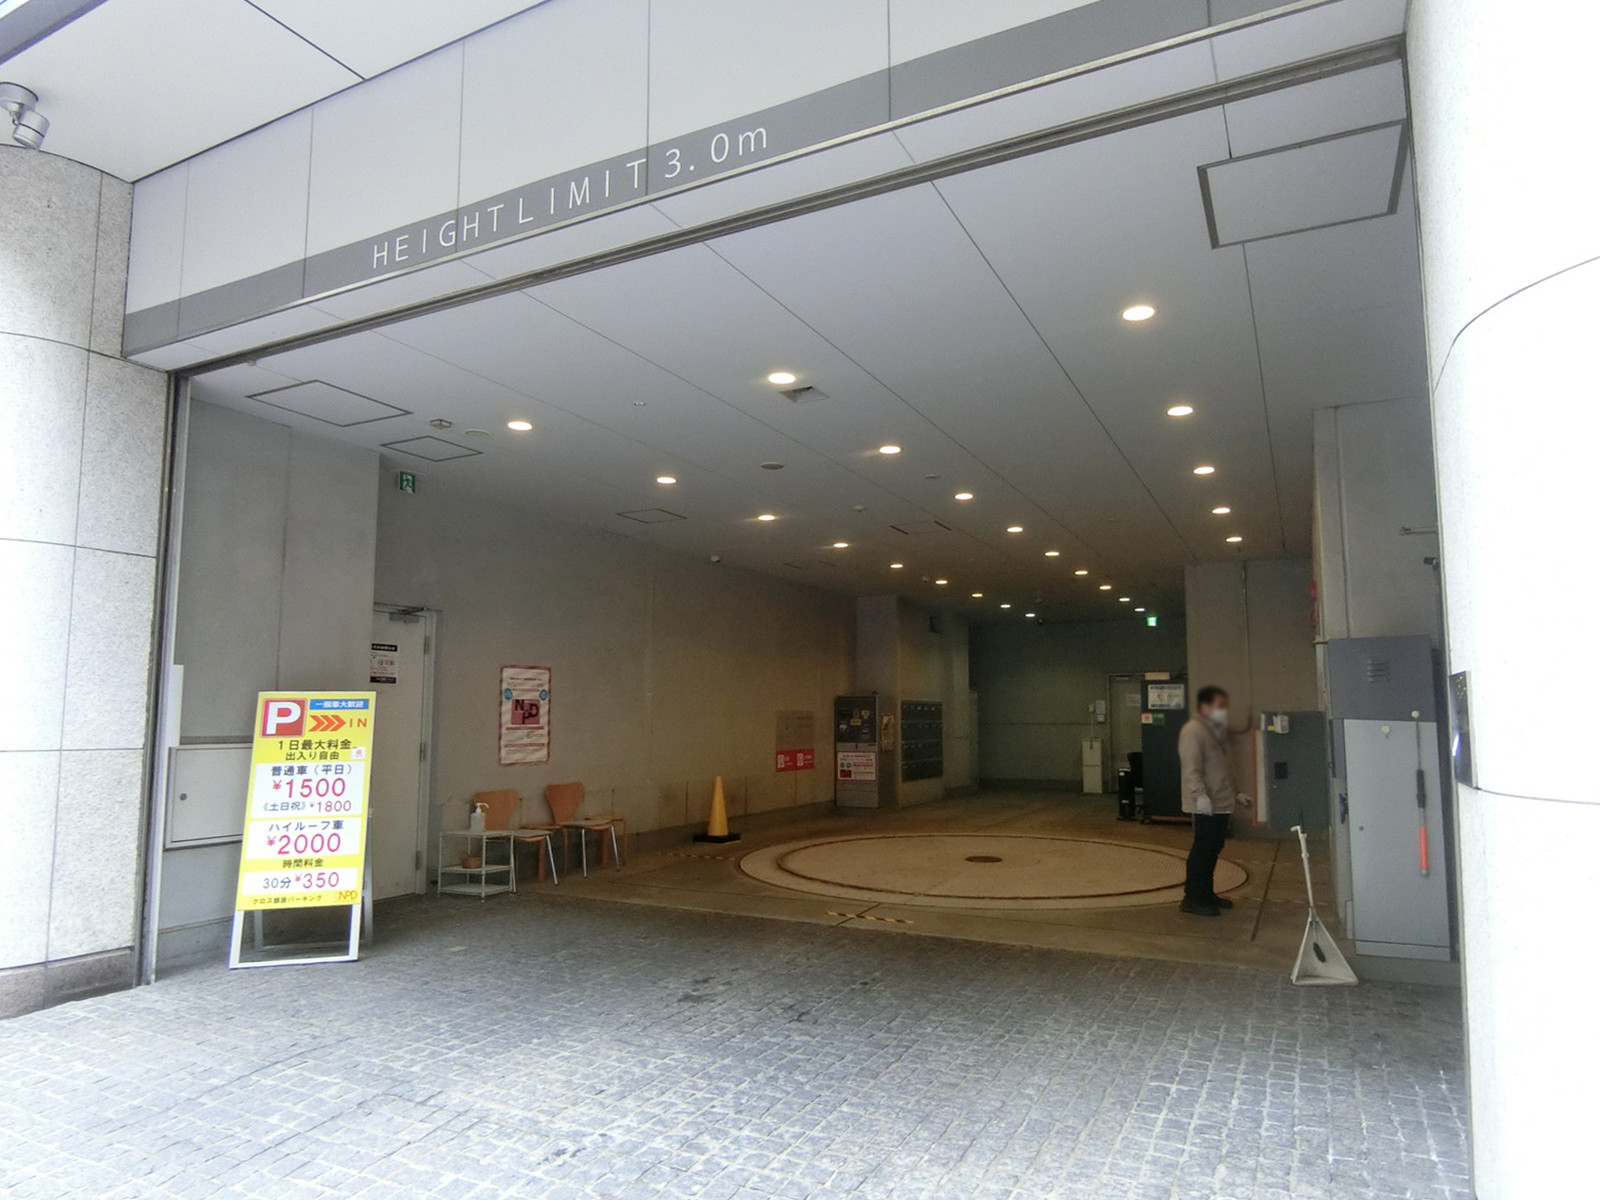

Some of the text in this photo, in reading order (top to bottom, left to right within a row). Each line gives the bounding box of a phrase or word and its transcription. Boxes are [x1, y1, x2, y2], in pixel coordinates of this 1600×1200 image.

[373, 204, 504, 268] HEIGHT
[518, 158, 647, 223] LIMIT
[265, 701, 302, 735] P
[349, 718, 367, 728] IN
[286, 751, 340, 761] 出入り自由
[272, 778, 346, 798] ¥1500
[268, 820, 344, 832] ハイルーフ車
[267, 833, 341, 855] ¥2000
[282, 858, 324, 868] 時間料金
[263, 872, 339, 889] 30分 ¥350
